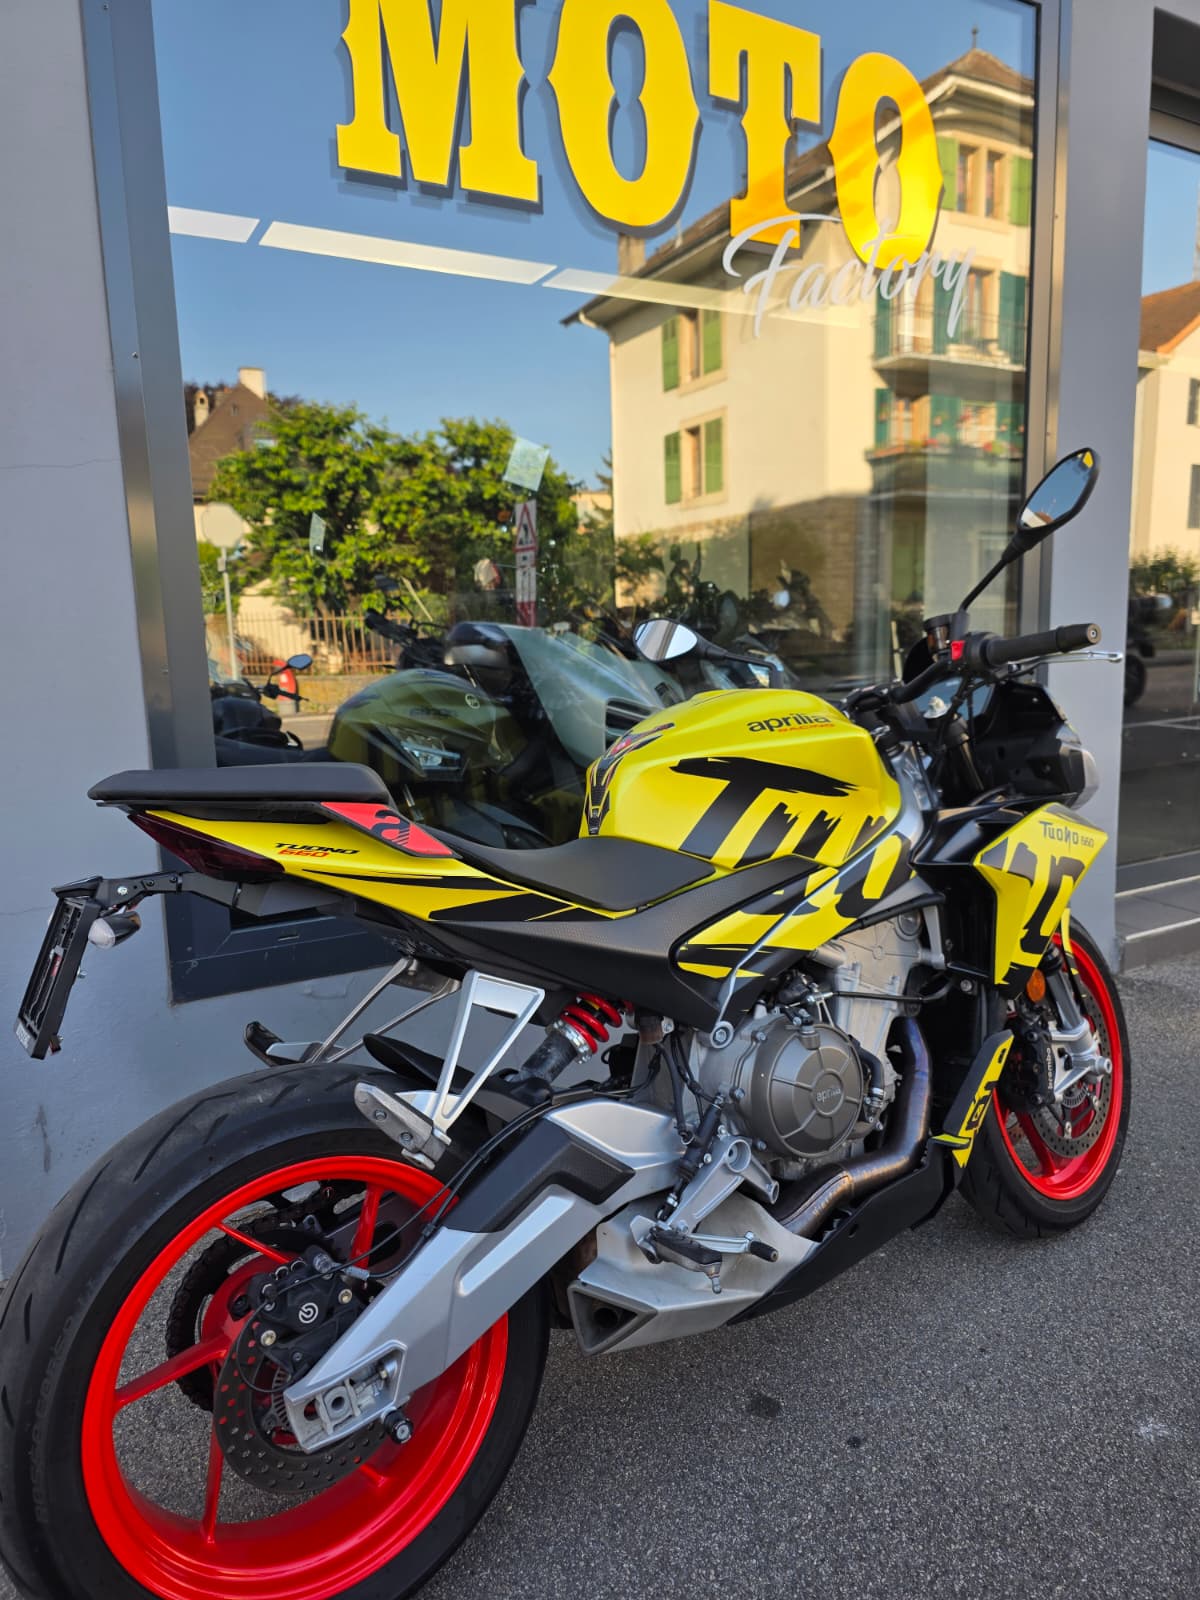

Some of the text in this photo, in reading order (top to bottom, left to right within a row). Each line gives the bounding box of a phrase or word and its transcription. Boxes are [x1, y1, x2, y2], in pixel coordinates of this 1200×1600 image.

[336, 0, 944, 271] MOTO
[722, 212, 976, 338] Factory
[746, 712, 832, 732] aprilia
[275, 842, 360, 854] TUONO
[278, 849, 329, 857] 660
[1046, 1047, 1054, 1089] brembo
